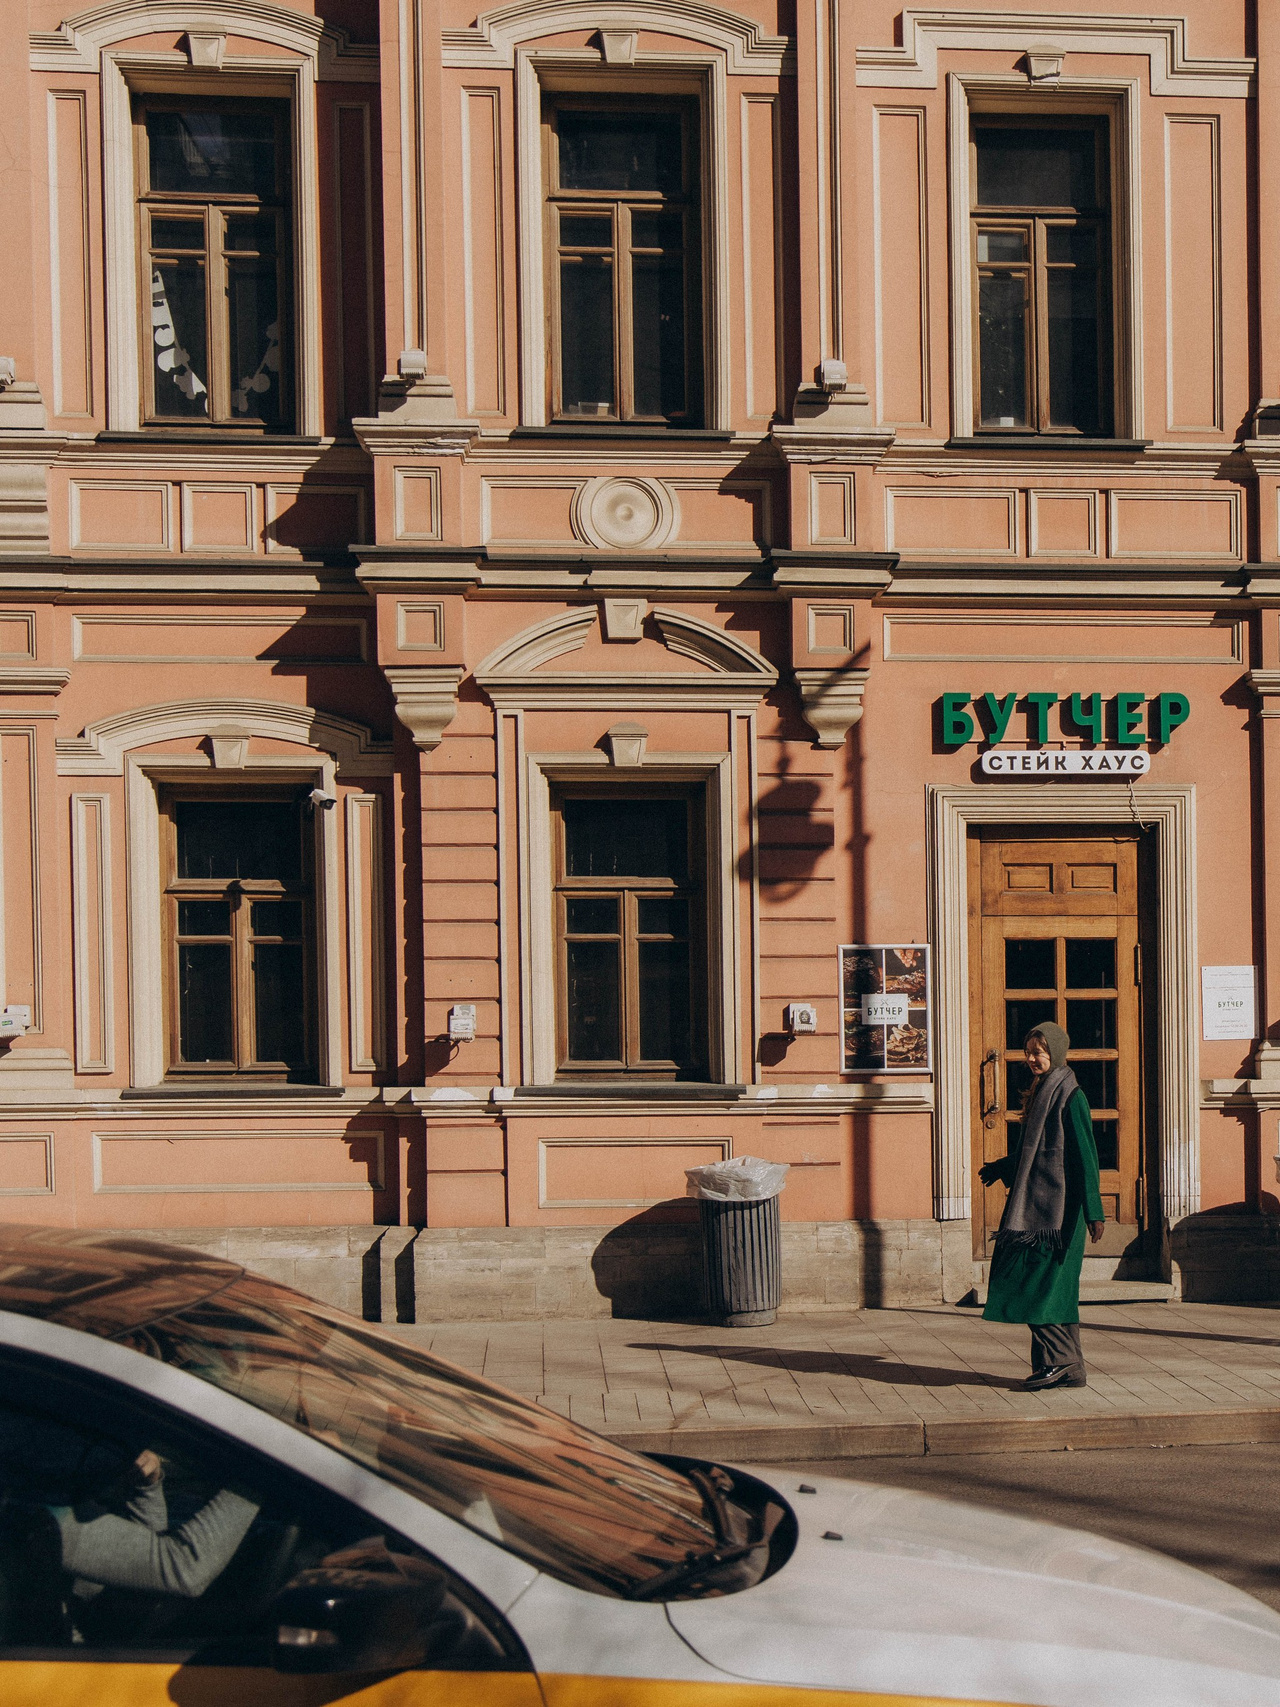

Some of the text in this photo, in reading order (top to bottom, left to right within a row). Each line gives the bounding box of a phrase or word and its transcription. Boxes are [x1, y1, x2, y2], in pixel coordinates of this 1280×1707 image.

[943, 692, 1190, 744] БУТЧЕР
[988, 752, 1145, 771] СТЕЙК ХАУС
[867, 1007, 903, 1016] БУТЧЕР
